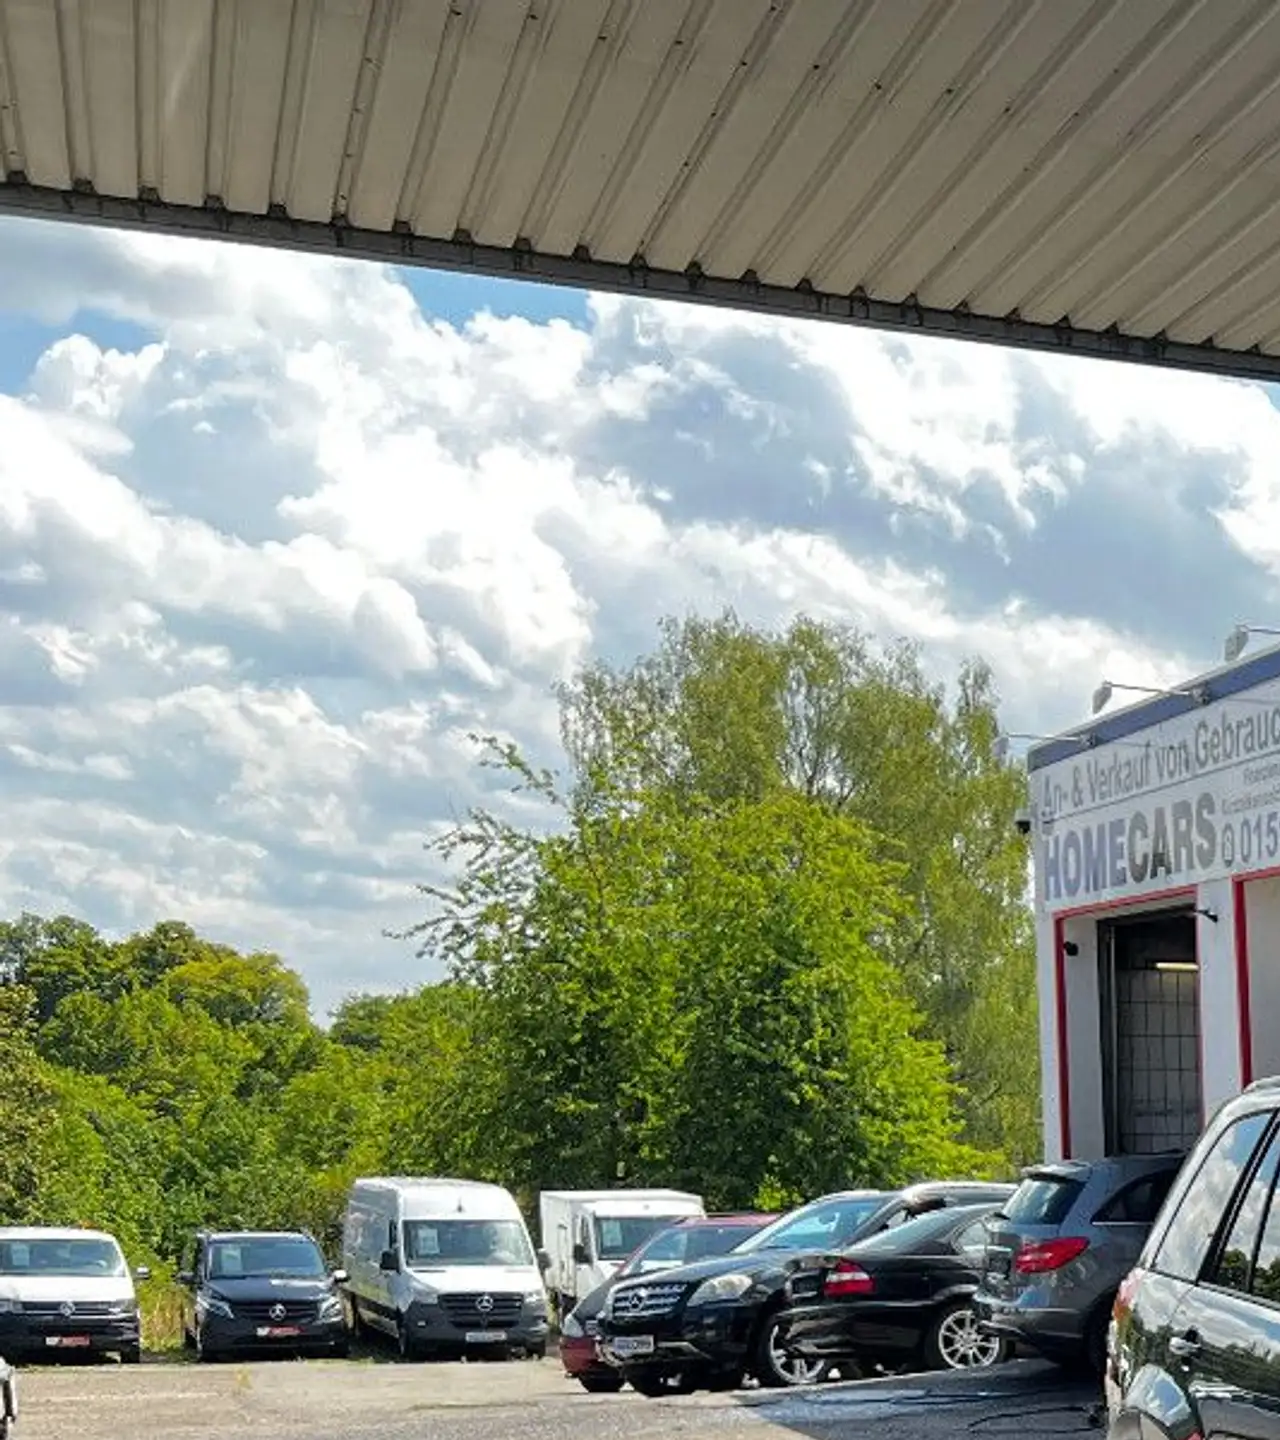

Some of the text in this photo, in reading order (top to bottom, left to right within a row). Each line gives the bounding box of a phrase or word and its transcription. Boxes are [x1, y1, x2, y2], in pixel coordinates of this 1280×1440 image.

[1071, 766, 1084, 808] &
[1087, 741, 1151, 803] Verkauf
[1155, 744, 1190, 784] von
[1044, 792, 1217, 902] HOMECARS
